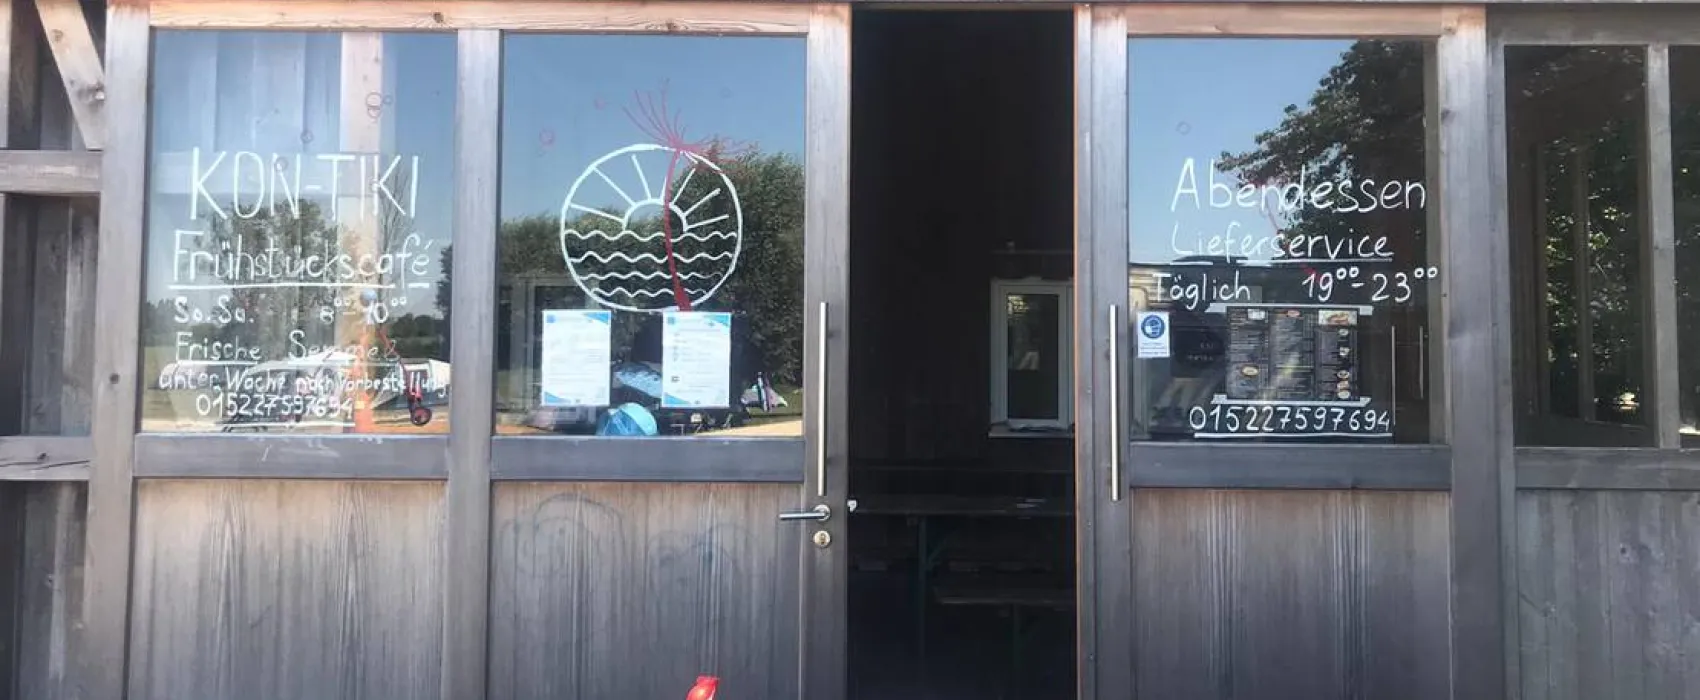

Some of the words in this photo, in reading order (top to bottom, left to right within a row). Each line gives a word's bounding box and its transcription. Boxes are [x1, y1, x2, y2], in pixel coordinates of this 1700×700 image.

[190, 146, 419, 221] KON-TIKI
[1170, 157, 1428, 214] Abendessen
[173, 229, 434, 288] Frühstückscafé
[1170, 220, 1394, 262] Lieferservice
[1152, 269, 1251, 309] Täglich
[175, 332, 262, 361] Frische
[195, 392, 354, 419] 015227597694
[1189, 405, 1391, 433] 015227597694
